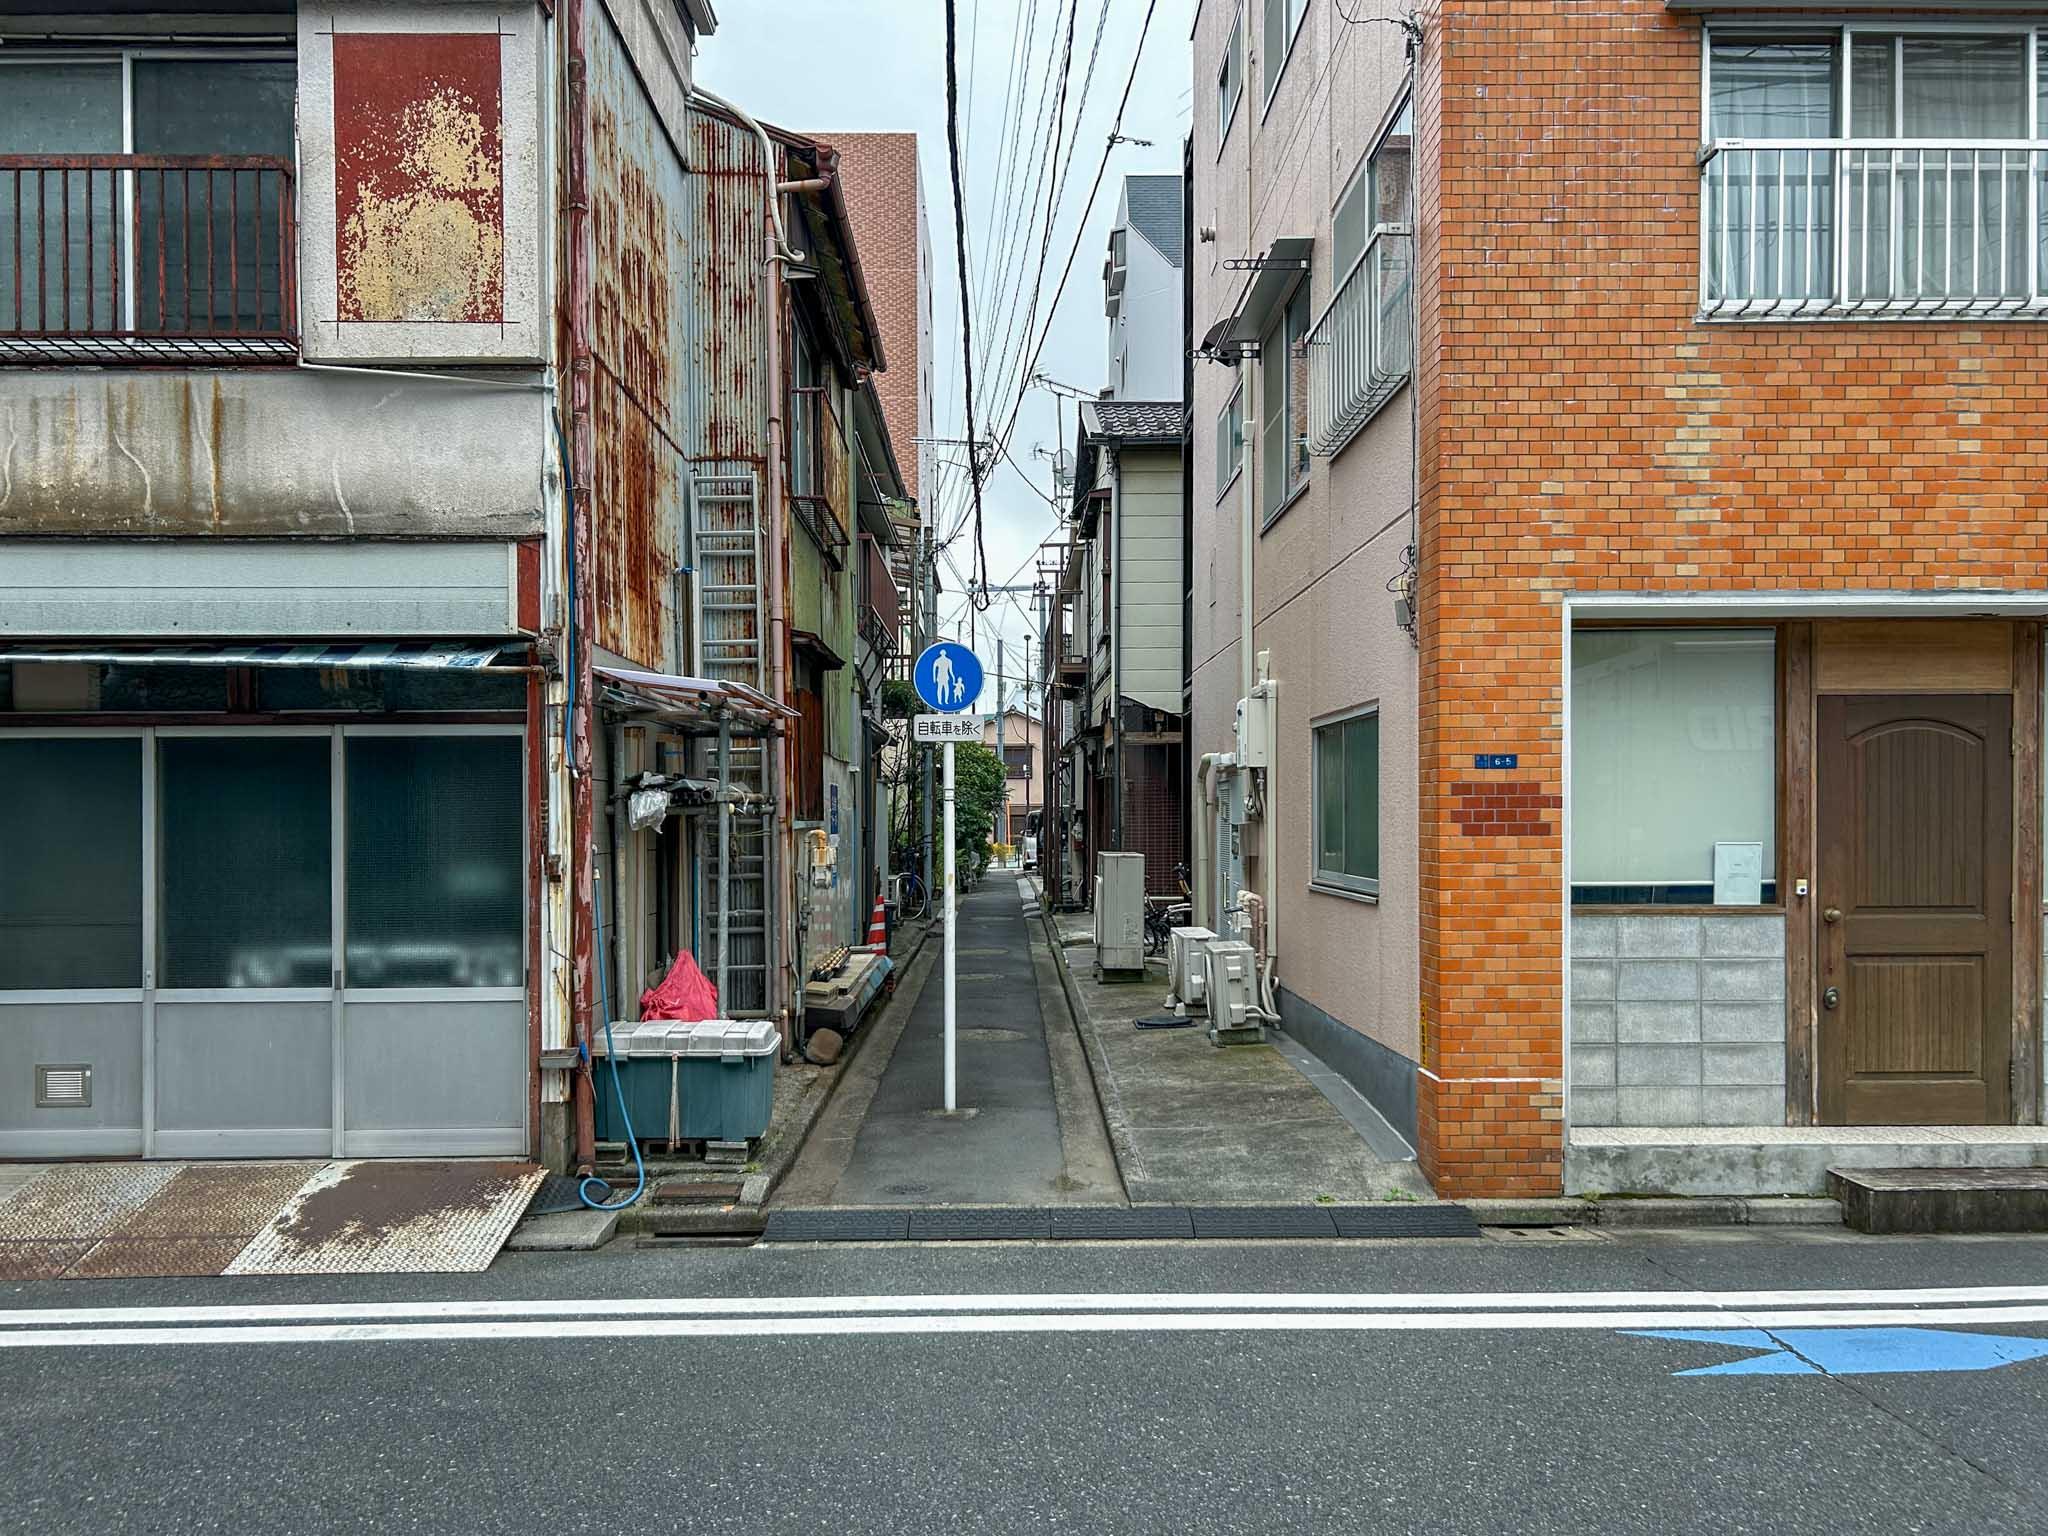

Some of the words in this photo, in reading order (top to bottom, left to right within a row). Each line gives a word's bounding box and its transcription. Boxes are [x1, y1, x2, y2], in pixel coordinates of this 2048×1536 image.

[918, 721, 981, 736] 自転車を除く
[1495, 757, 1511, 765] 6-5
